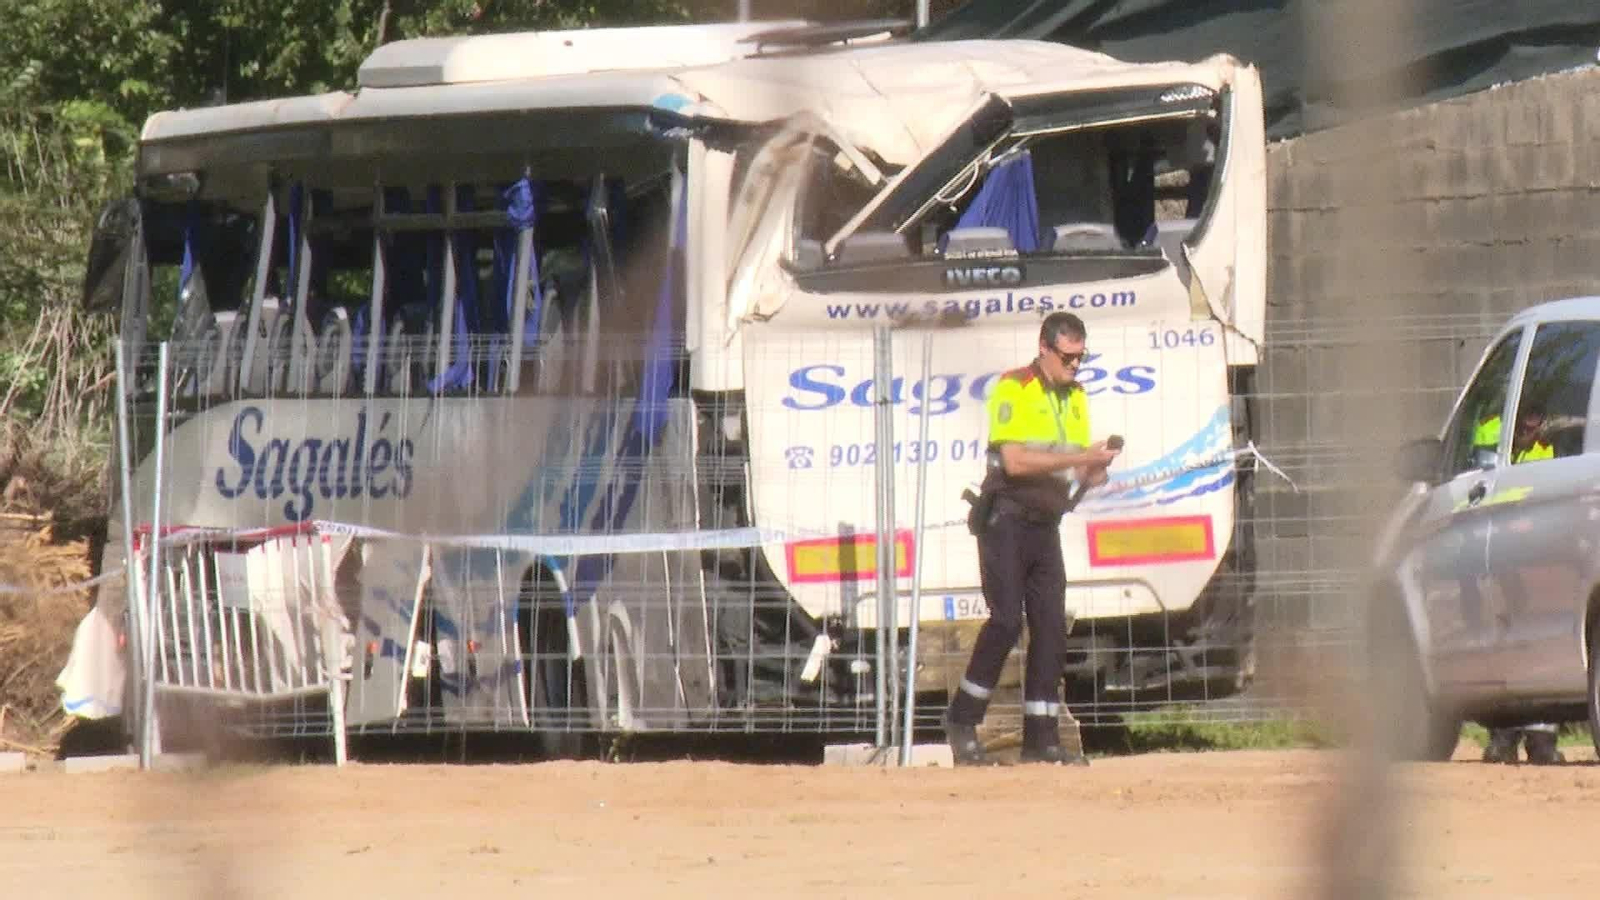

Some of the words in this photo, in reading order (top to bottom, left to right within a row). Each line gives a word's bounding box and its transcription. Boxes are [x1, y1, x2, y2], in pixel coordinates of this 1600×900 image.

[826, 287, 1137, 320] www.sagales.com
[1148, 327, 1215, 350] 1046
[781, 352, 1157, 417] Sagés
[215, 405, 415, 522] Sagalés
[829, 442, 878, 467] 902
[892, 440, 938, 464] 130
[950, 438, 987, 461] 01
